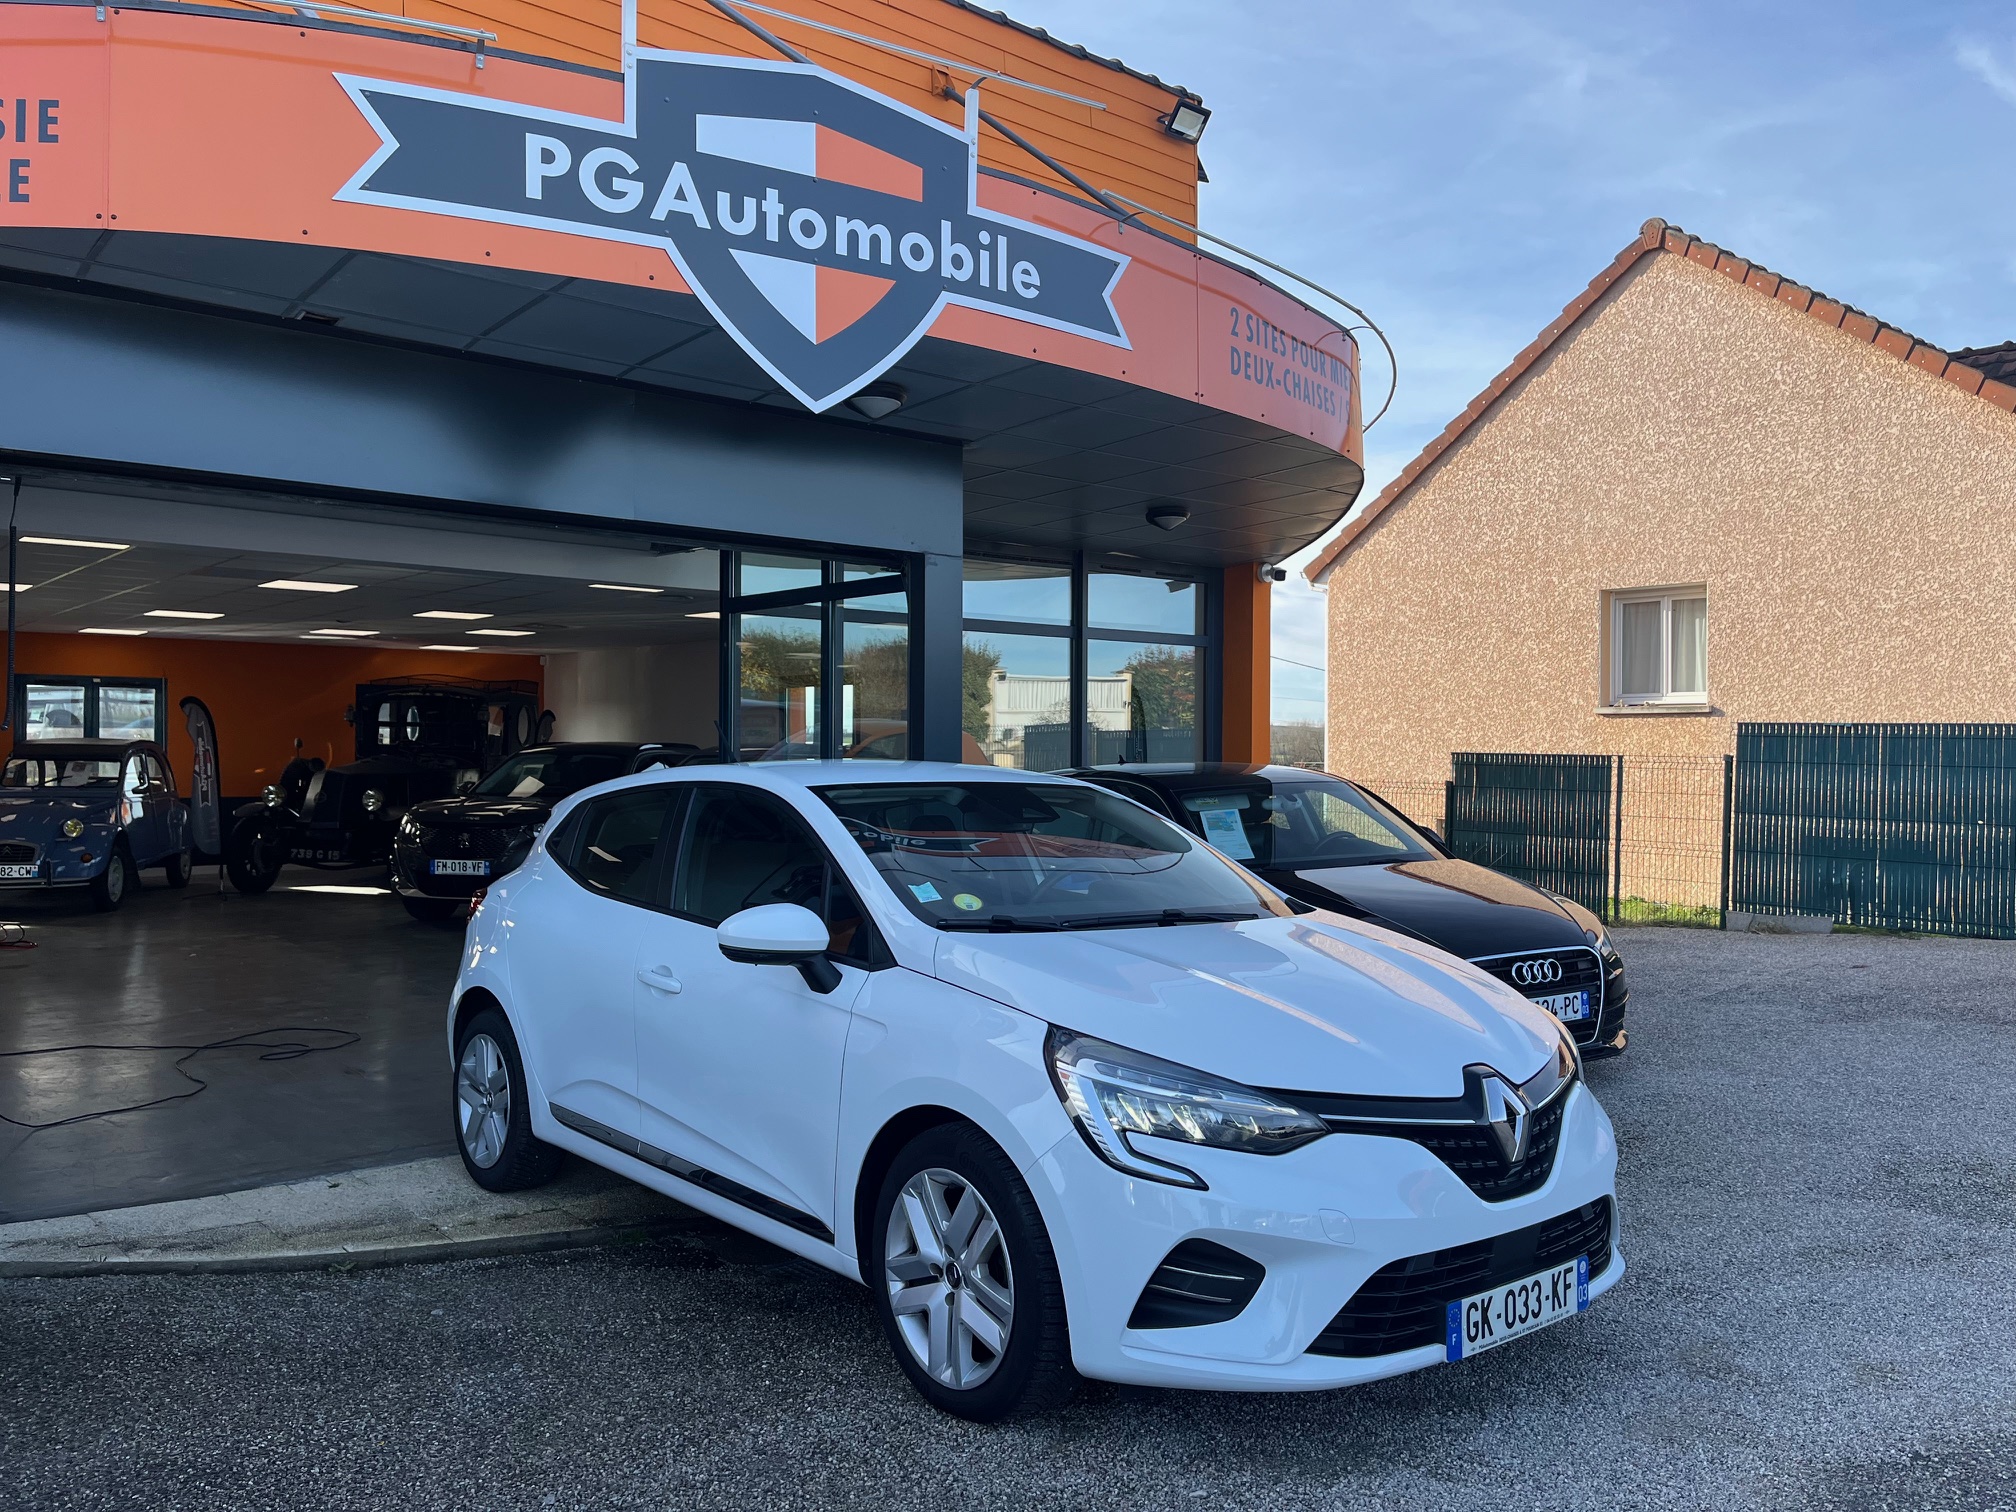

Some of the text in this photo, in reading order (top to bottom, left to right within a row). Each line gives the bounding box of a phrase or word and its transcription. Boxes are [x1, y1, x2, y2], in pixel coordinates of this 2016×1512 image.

[0, 158, 31, 203] E
[525, 132, 1041, 299] PGAutomobile
[1230, 307, 1351, 392] 2 SITES POUR MIE
[1230, 345, 1336, 417] DEUX-CHAISES
[1535, 995, 1580, 1017] 34-PC
[1466, 1265, 1574, 1343] GK-033-KF
[1578, 1283, 1588, 1303] 03
[1451, 1333, 1457, 1346] F
